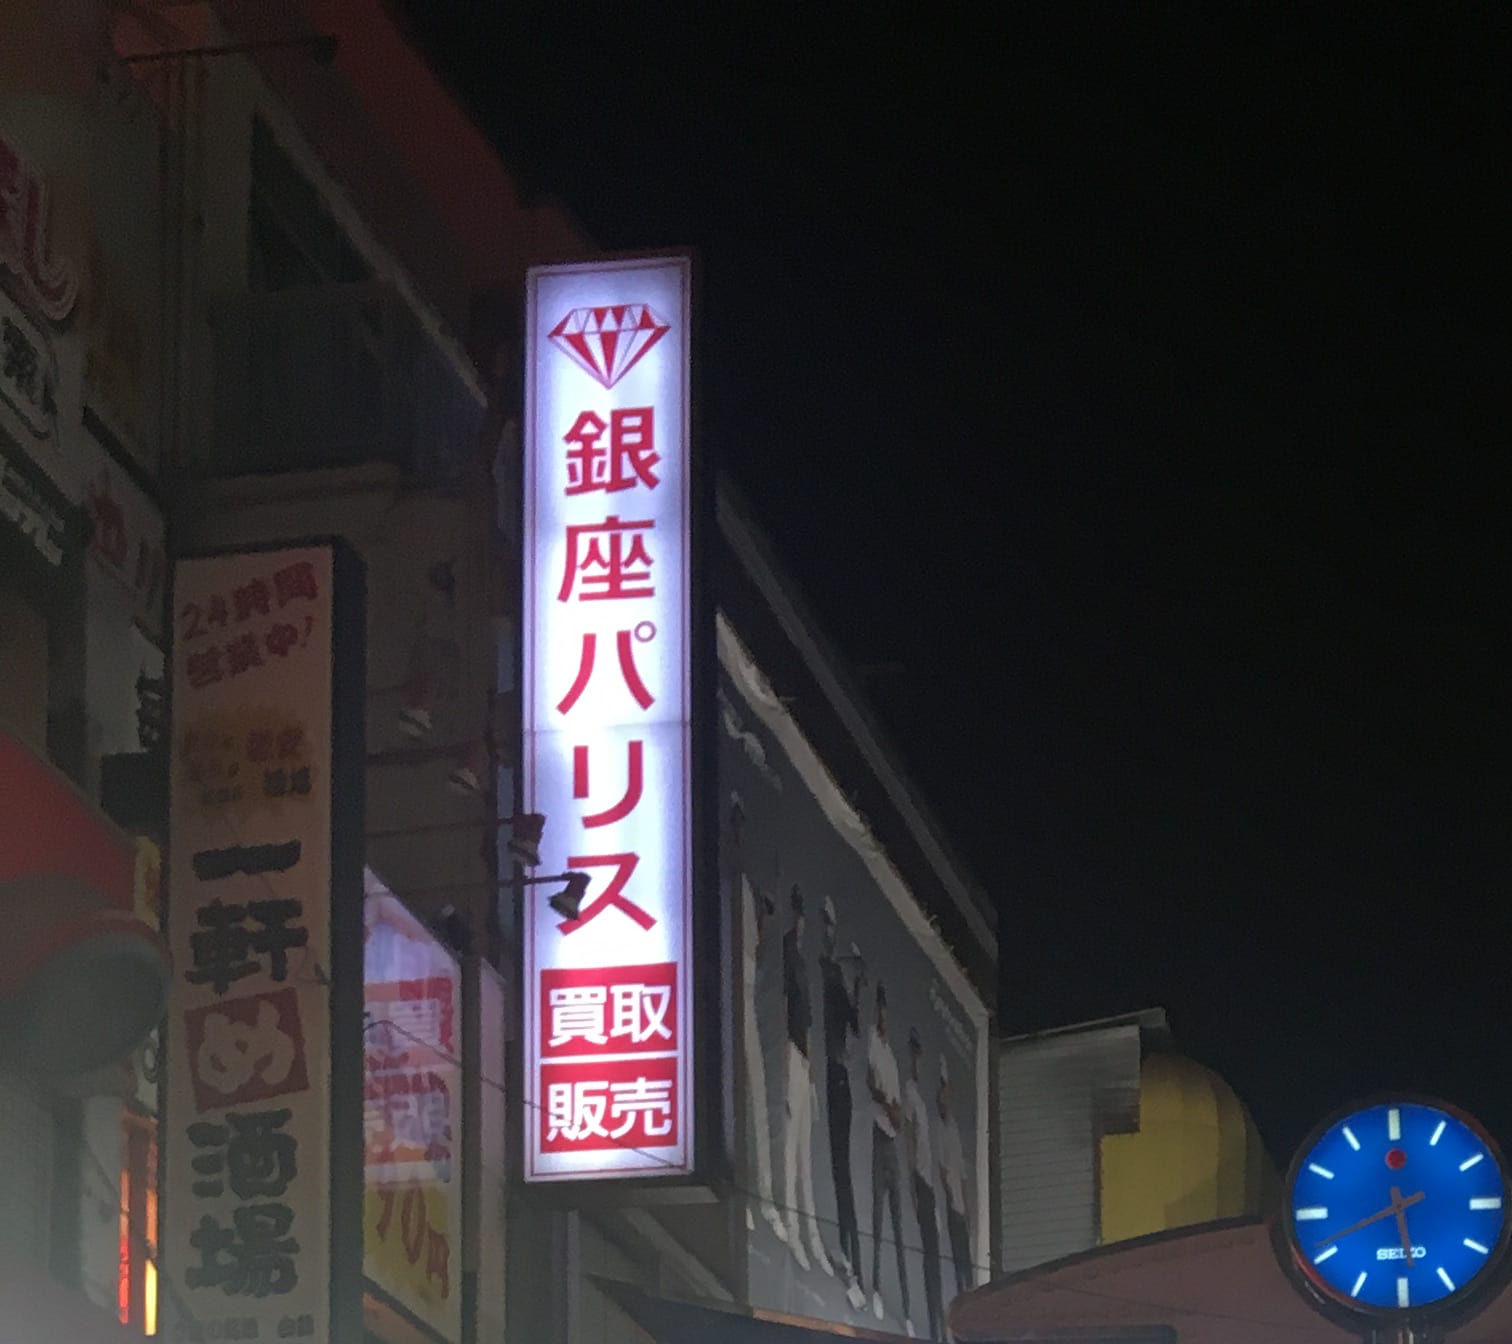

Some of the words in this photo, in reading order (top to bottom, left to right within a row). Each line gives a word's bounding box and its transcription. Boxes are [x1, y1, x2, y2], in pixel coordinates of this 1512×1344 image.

[181, 561, 318, 641] 24時間
[556, 406, 660, 936] 銀座パリス
[549, 983, 672, 1047] 買取
[185, 840, 308, 1297] 一軒め酒場
[547, 1077, 673, 1142] 販売
